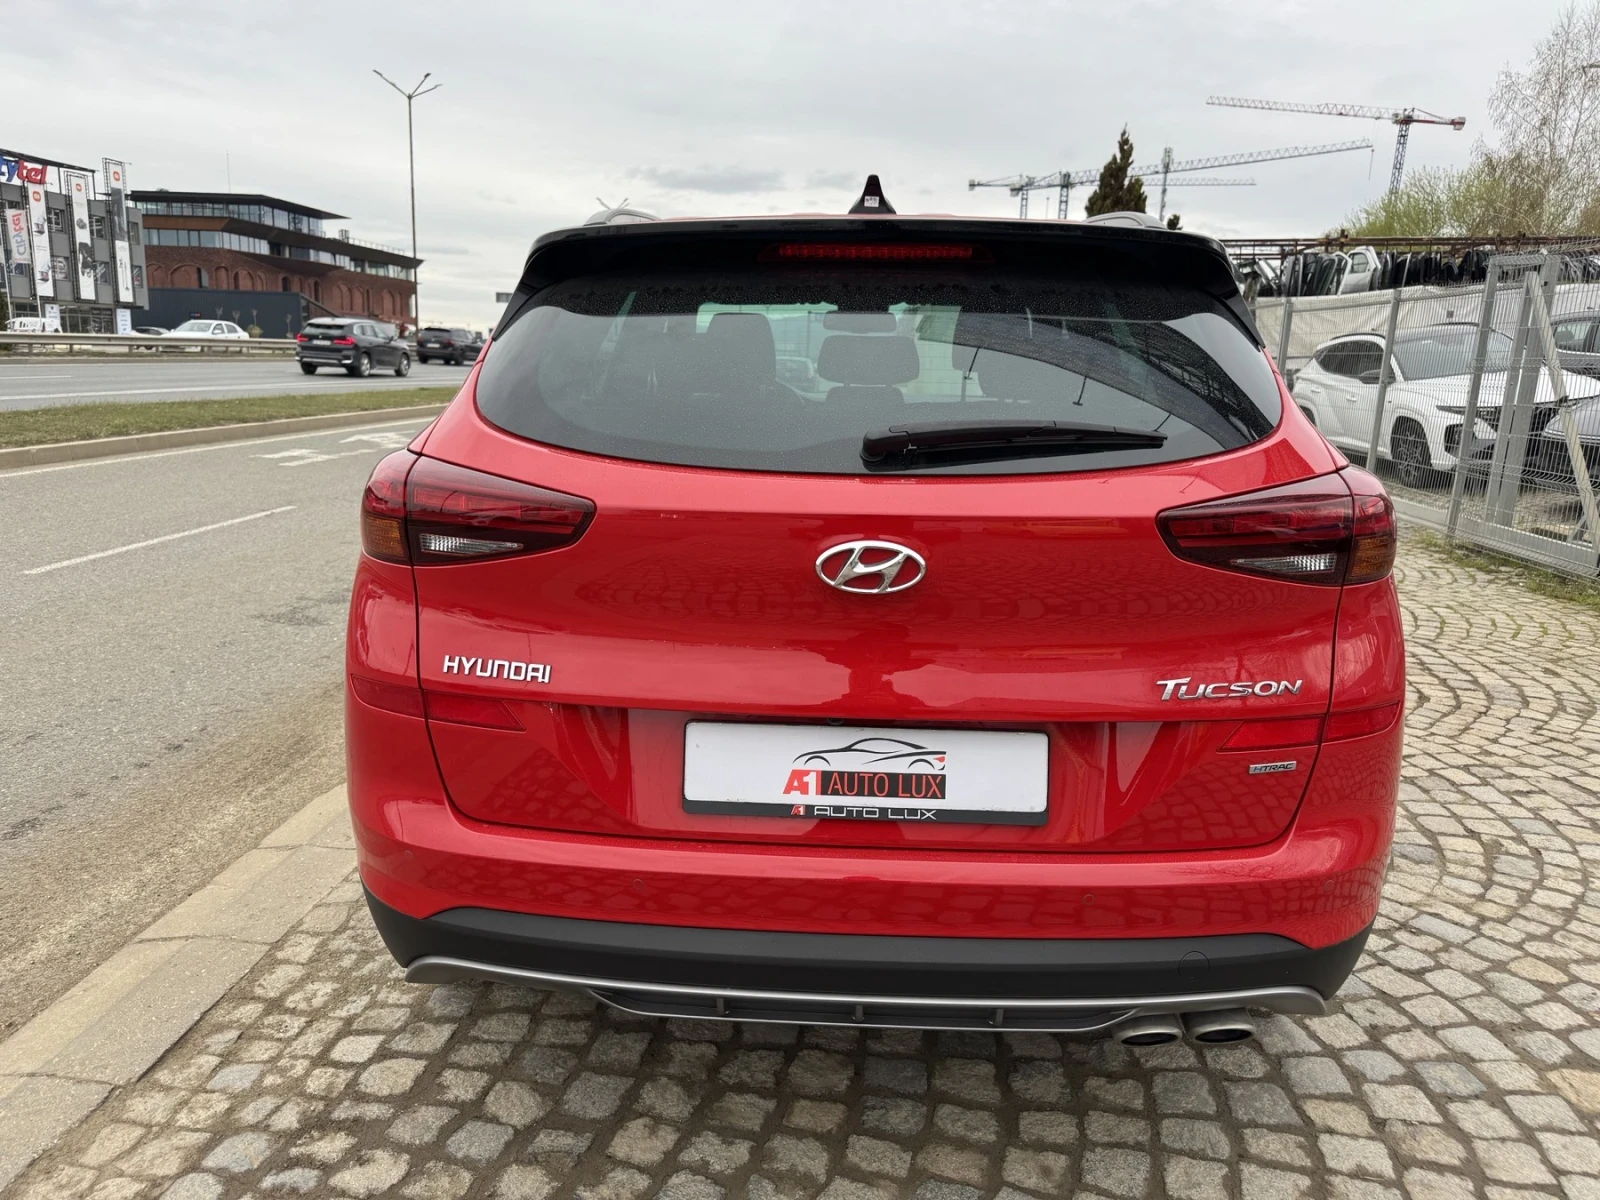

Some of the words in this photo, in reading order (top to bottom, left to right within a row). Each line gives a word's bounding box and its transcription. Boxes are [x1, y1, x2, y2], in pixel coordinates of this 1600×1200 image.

[442, 654, 551, 684] HYUNDAI
[1251, 762, 1295, 773] HTRAC
[782, 769, 821, 796] A1
[827, 772, 889, 796] AUTO
[898, 774, 942, 798] LUX
[791, 805, 805, 815] A1
[814, 806, 879, 818] AUTO
[888, 808, 937, 820] LUX
